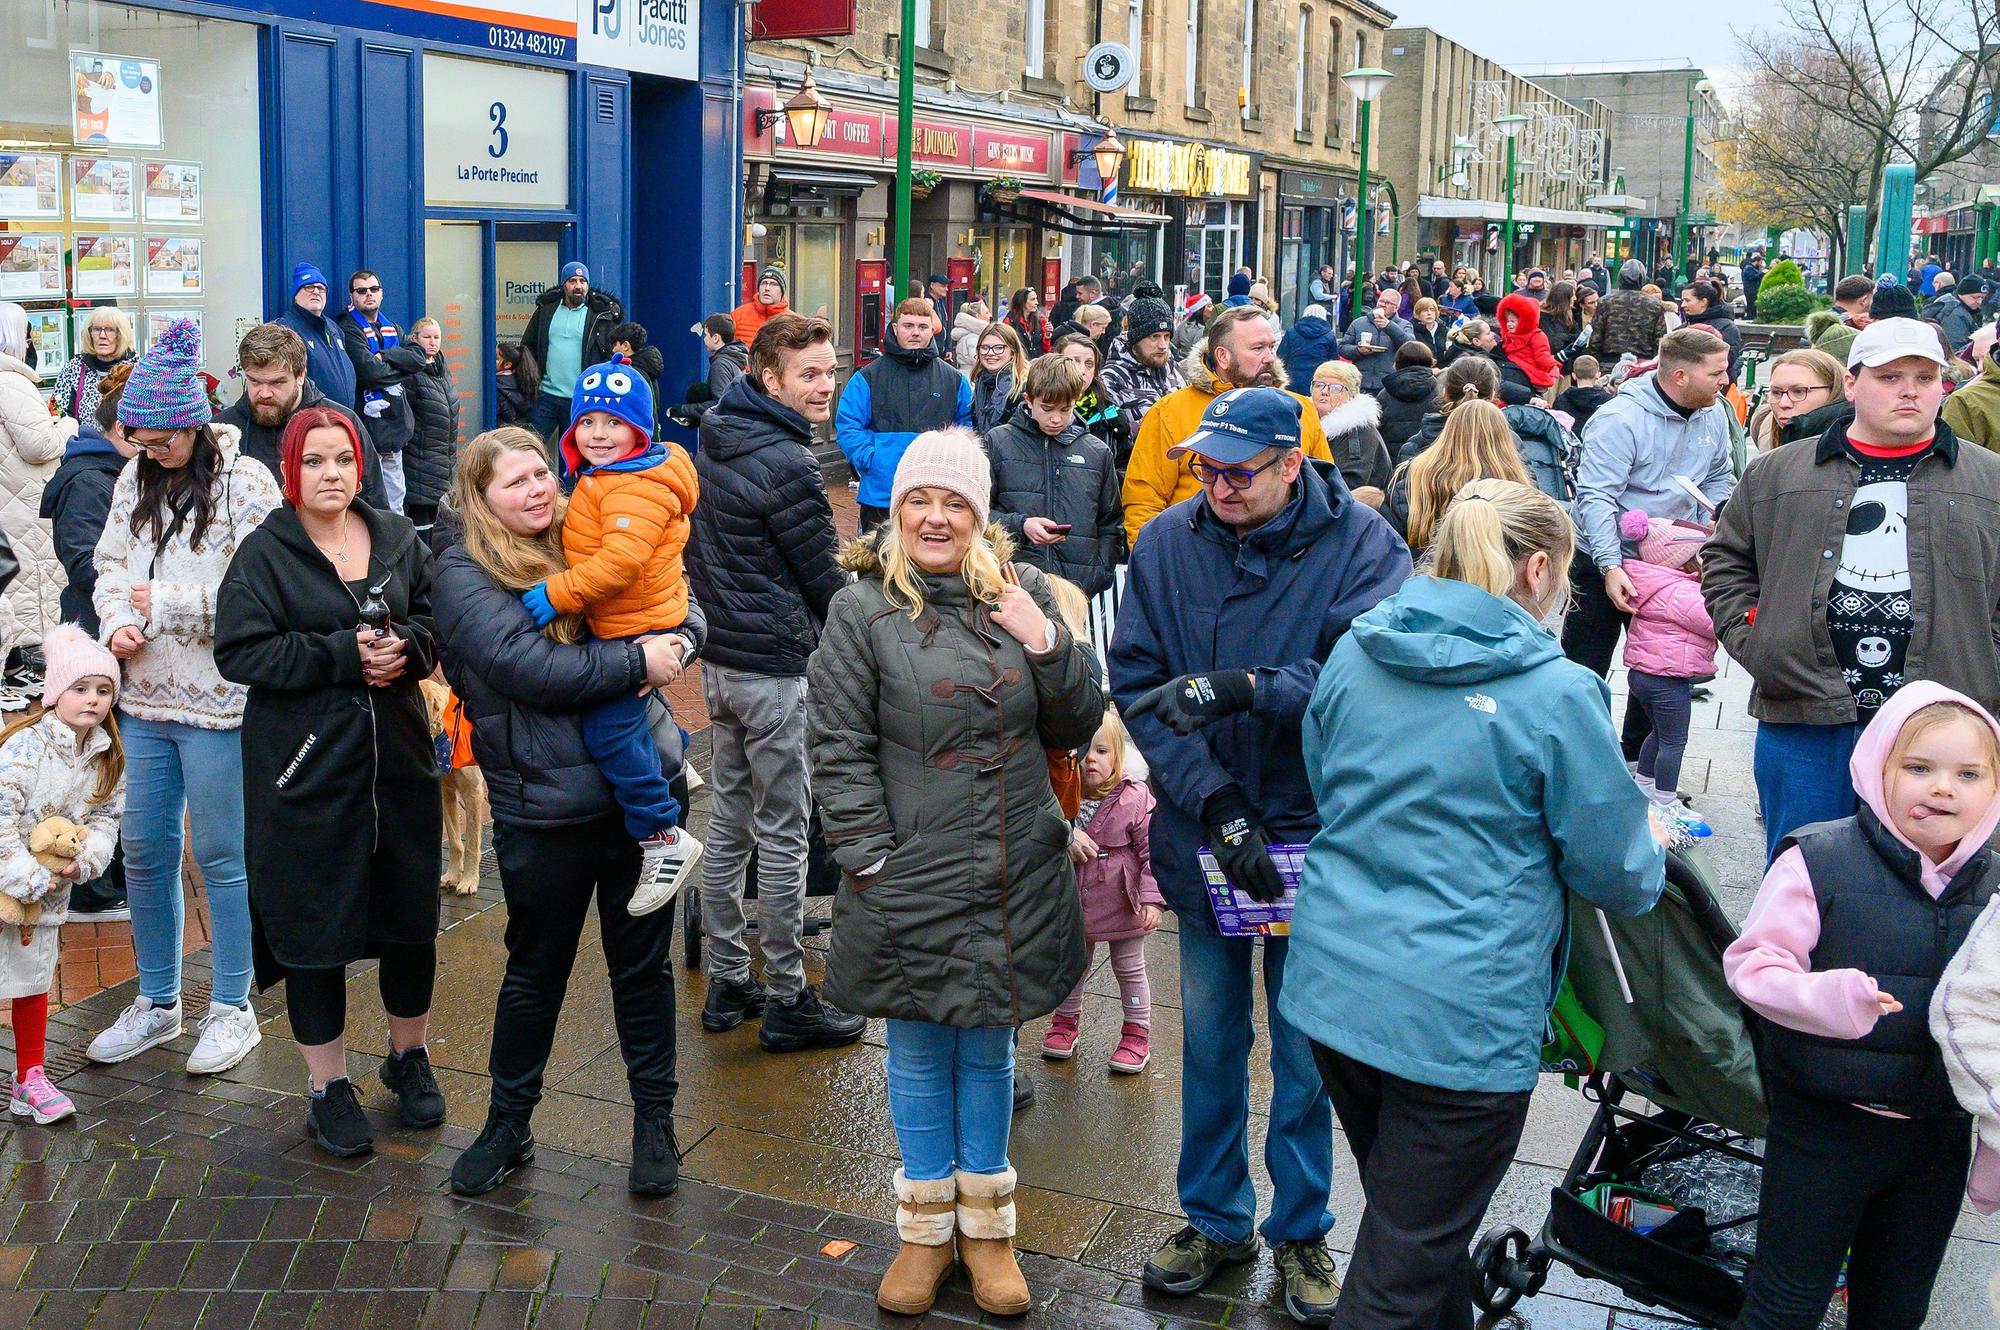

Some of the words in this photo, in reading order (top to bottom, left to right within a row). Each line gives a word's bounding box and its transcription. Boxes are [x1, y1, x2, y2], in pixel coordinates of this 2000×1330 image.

[638, 0, 687, 25] Pacitti
[489, 26, 525, 50] 01324
[526, 33, 566, 57] 482197
[638, 16, 686, 50] Jones
[488, 102, 508, 158] 3
[843, 121, 870, 144] COFFEE
[924, 127, 959, 158] DUNDAS
[458, 164, 470, 180] La
[472, 166, 499, 181] Porte
[500, 168, 538, 184] Precinct
[505, 281, 546, 298] Pacitti
[506, 293, 540, 304] Jone
[1220, 421, 1229, 430] F1
[1229, 423, 1248, 435] Team
[283, 760, 299, 778] LOVE
[295, 742, 311, 762] LOVE
